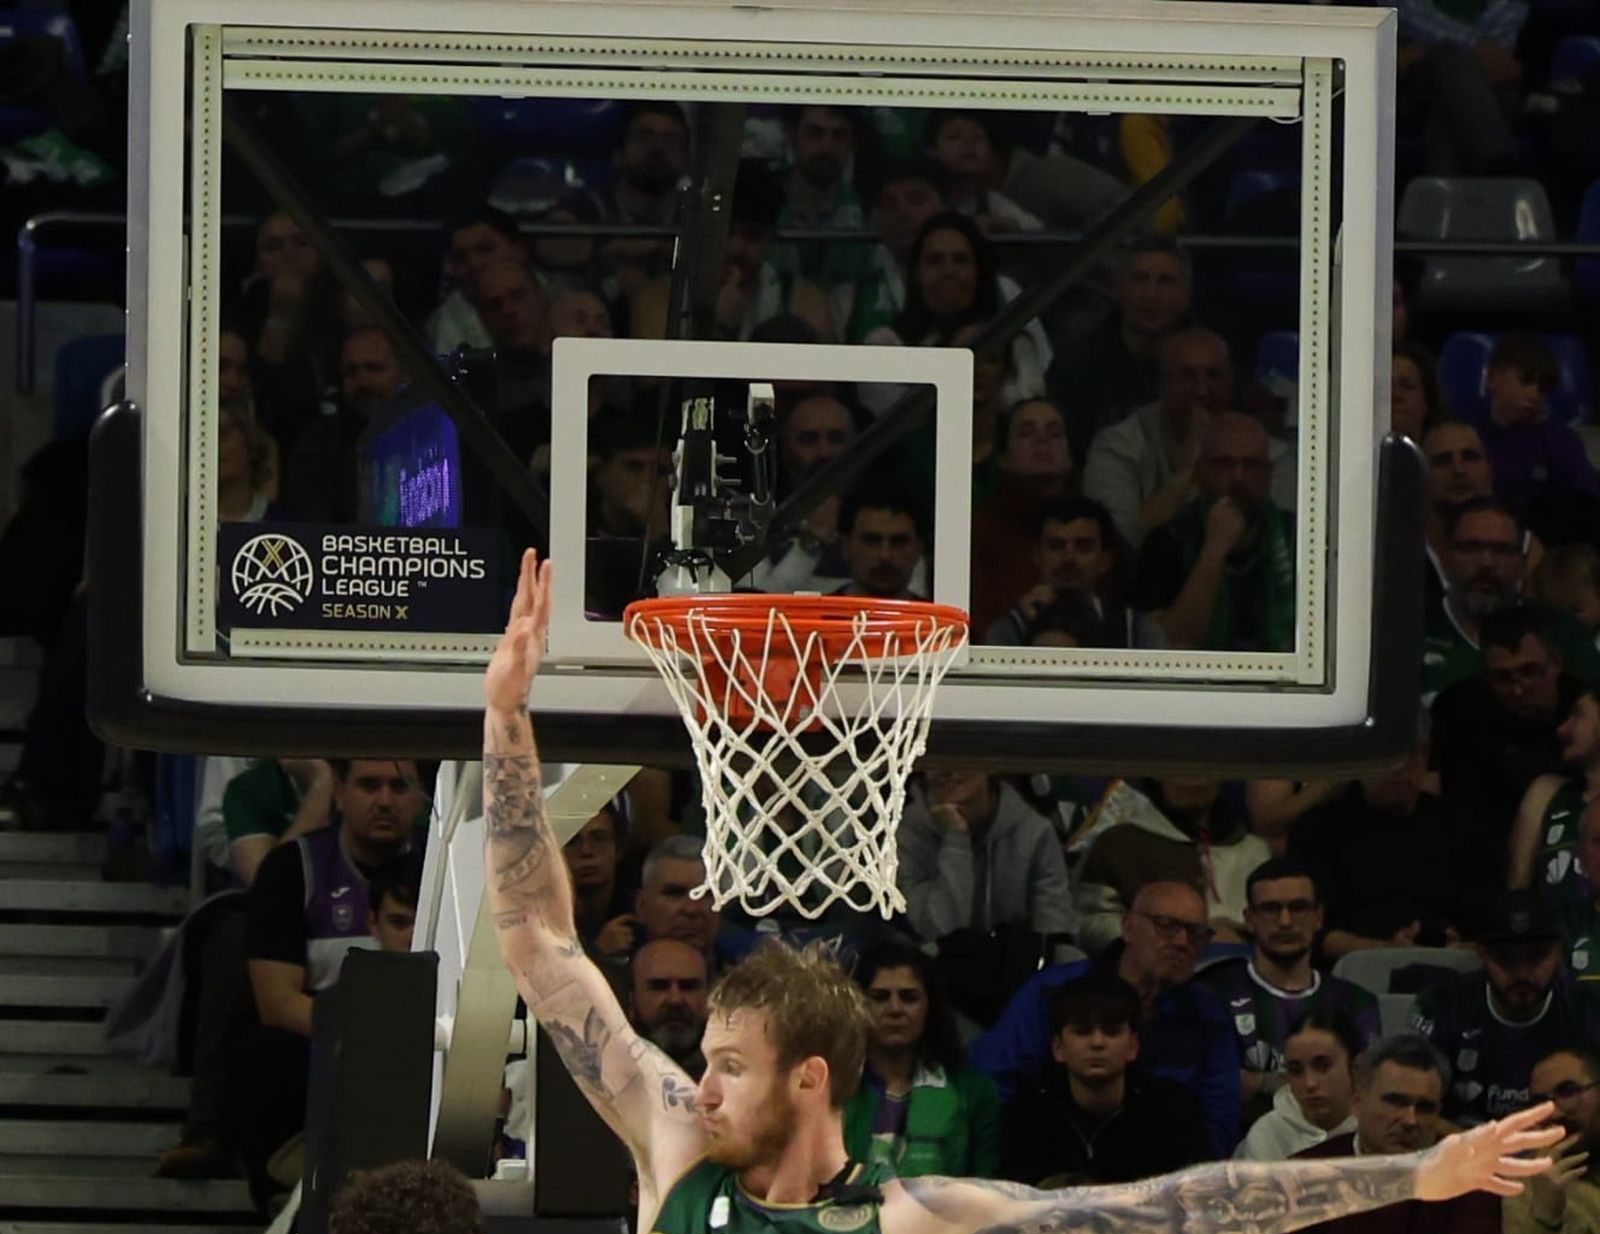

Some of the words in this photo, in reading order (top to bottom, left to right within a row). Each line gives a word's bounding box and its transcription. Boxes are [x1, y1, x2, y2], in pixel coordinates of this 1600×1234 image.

[322, 535, 468, 555] BASKETBALL
[322, 556, 486, 579] CHAMPIONS
[322, 579, 409, 597] LEAGUE
[322, 603, 391, 619] SEASON
[395, 605, 409, 620] X
